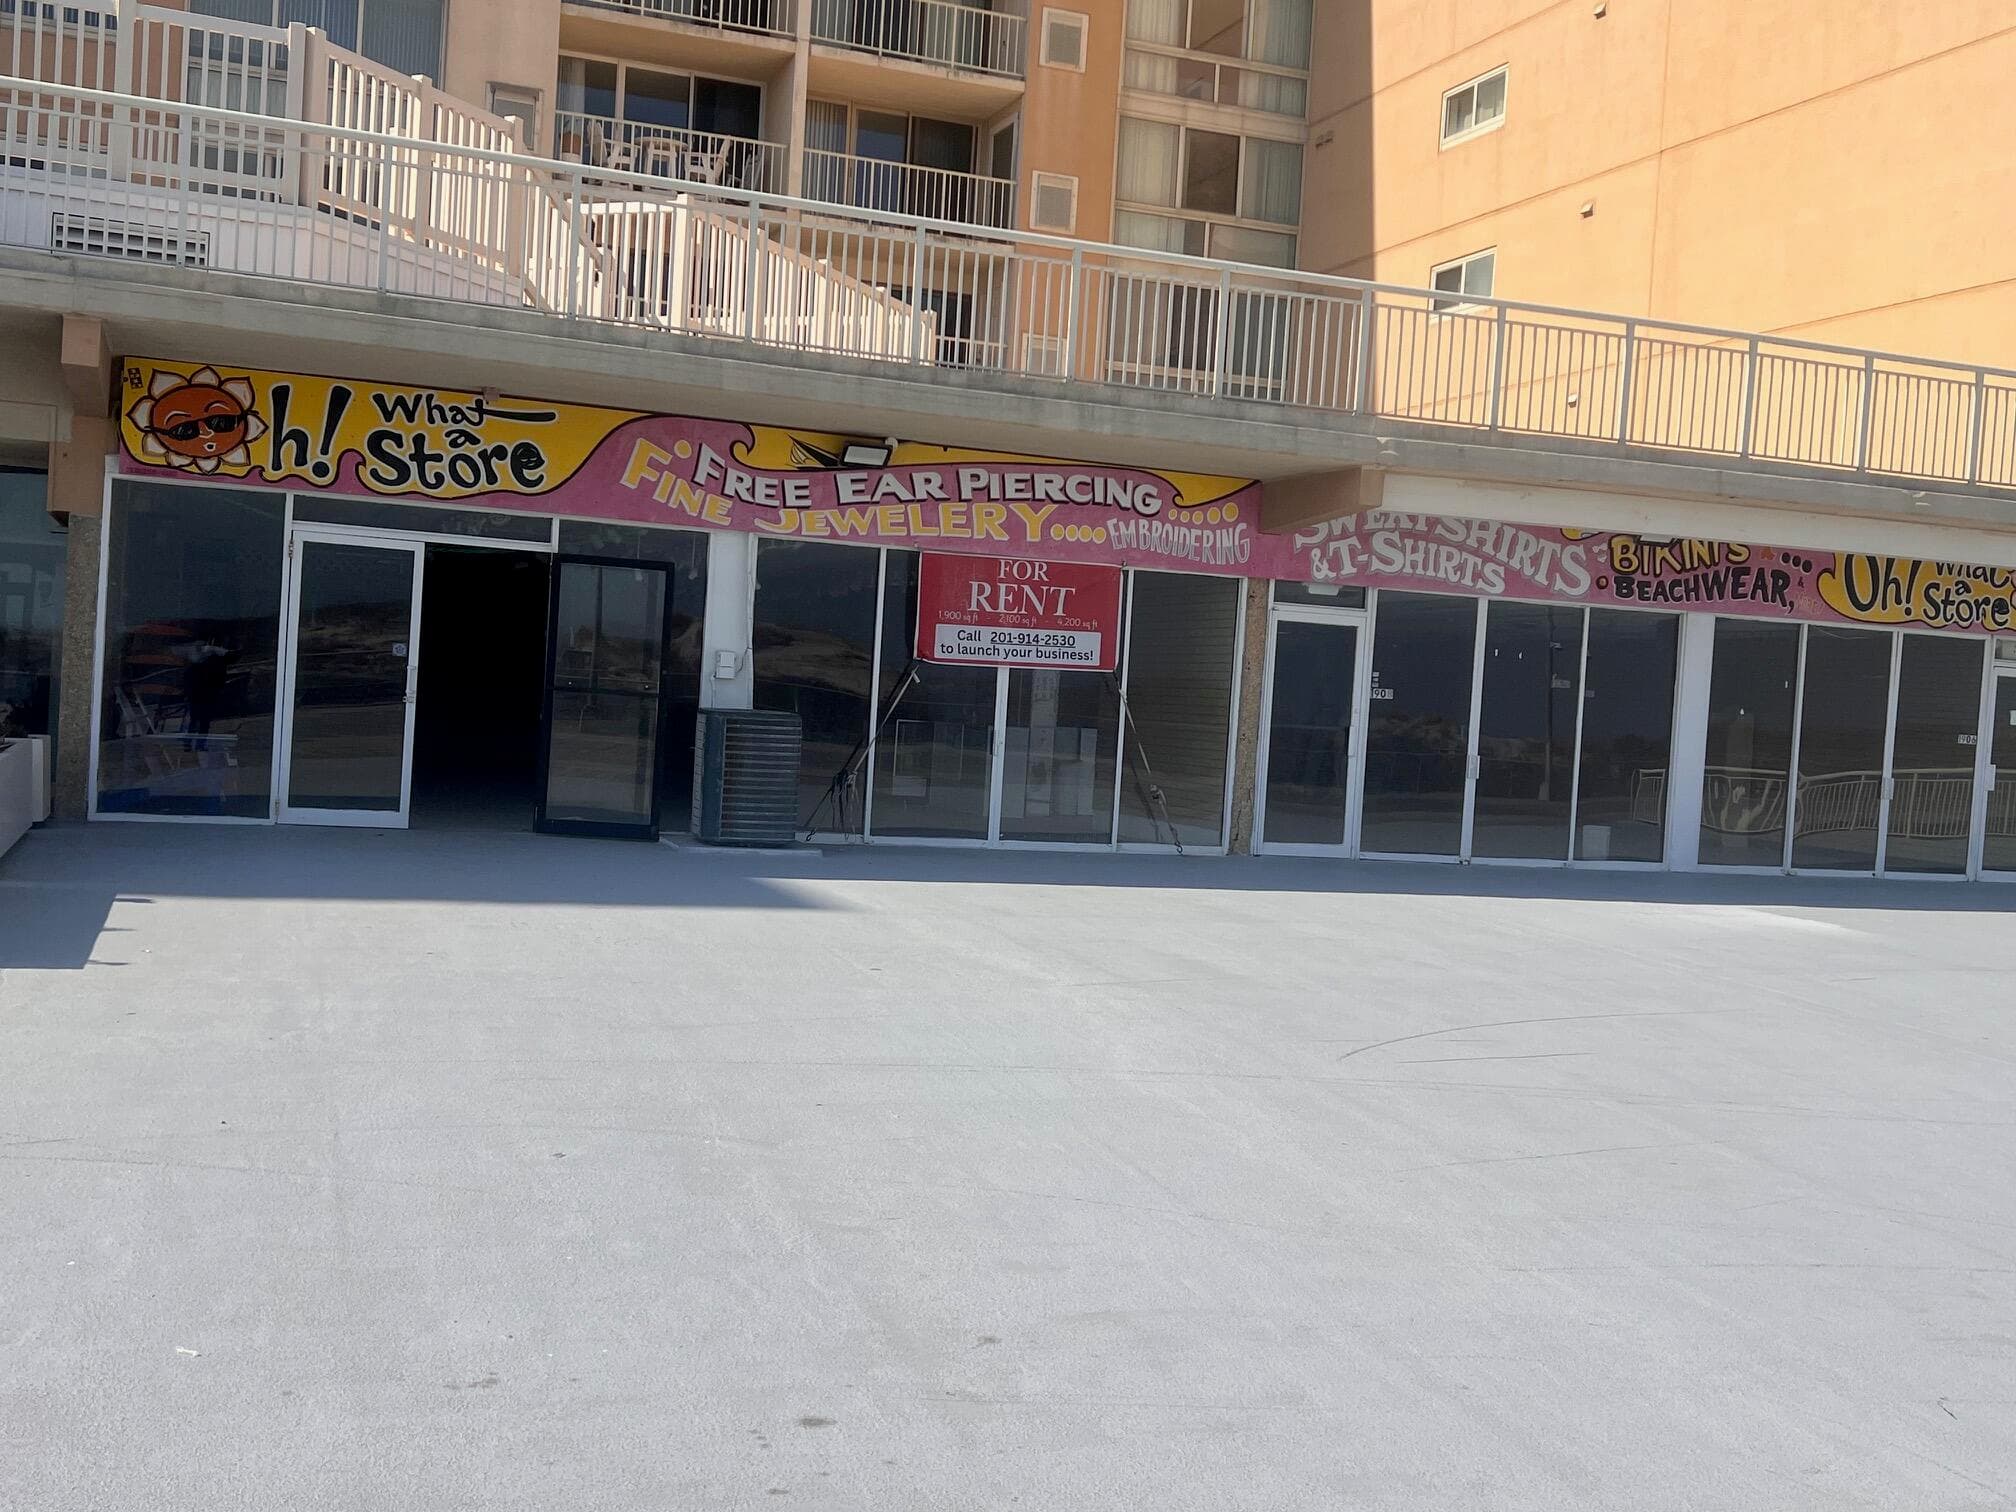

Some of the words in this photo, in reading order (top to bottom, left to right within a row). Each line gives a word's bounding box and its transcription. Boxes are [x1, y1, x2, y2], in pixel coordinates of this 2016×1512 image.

[373, 393, 556, 427] What
[446, 429, 481, 448] a
[366, 430, 546, 490] Store
[691, 443, 812, 508] FREE
[834, 472, 950, 505] EAR
[956, 468, 1163, 517] PIERCING
[754, 502, 1057, 542] JEWELERY
[1106, 518, 1251, 566] EMBROIDERING
[998, 559, 1049, 582] FOR
[1310, 546, 1335, 580] &
[1329, 530, 1506, 595] T-SHIRTS
[1609, 533, 1752, 577] BIKINIS
[967, 580, 1076, 617] RENT
[1844, 553, 1923, 617] Oh!
[1922, 581, 2010, 627] Store
[1954, 580, 1972, 596] a
[940, 643, 953, 654] to
[957, 643, 1000, 656] launch
[1003, 647, 1032, 660] your
[1036, 648, 1094, 661] business!
[957, 629, 981, 642] Call
[990, 632, 1077, 647] 201-914-2530
